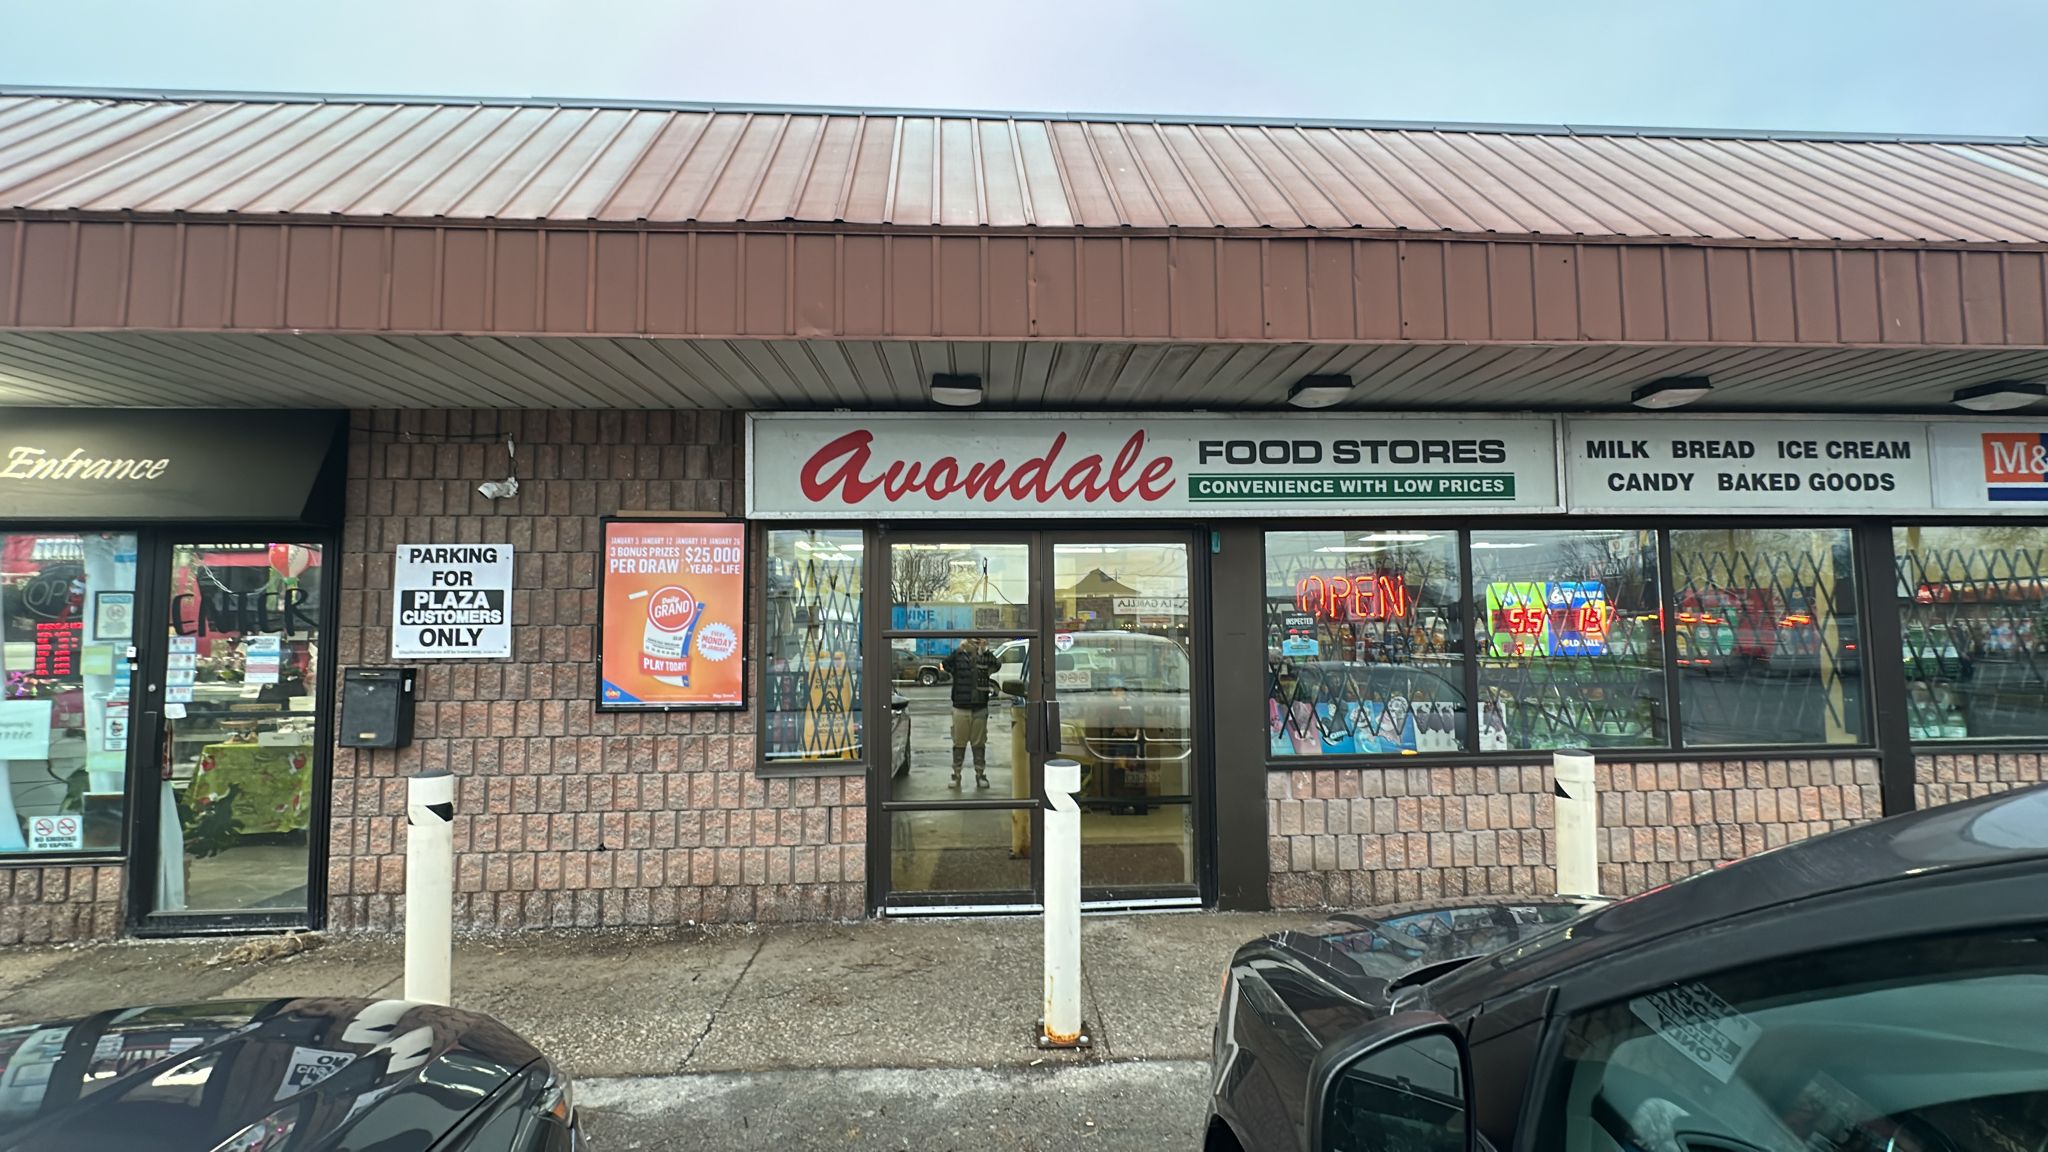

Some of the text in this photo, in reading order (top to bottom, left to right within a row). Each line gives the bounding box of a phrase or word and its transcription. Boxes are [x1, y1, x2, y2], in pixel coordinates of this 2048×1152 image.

[1198, 439, 1506, 465] FOOD STORES
[1585, 440, 1911, 460] MILK BREAD ICE CREAM
[0, 446, 171, 481] Entrance
[800, 428, 1176, 504] Avondale
[1198, 478, 1505, 494] CONVENIENCE WITH LOW PRICES
[1607, 472, 1896, 492] CANDY BAKED GOODS
[409, 547, 498, 564] PARKING
[610, 546, 680, 557] 3 BONUS PRIZES
[610, 558, 680, 574] PER DRAW
[689, 564, 713, 575] YEAR
[721, 564, 741, 575] LIFE
[432, 570, 473, 586] FOR
[414, 591, 490, 610] PLAZA
[1298, 574, 1406, 618] OPEN
[402, 610, 502, 624] CUSTOMERS
[655, 600, 690, 619] GRAND
[419, 628, 484, 647] ONLY
[701, 635, 734, 648] MONDAY
[643, 657, 664, 671] PLAY
